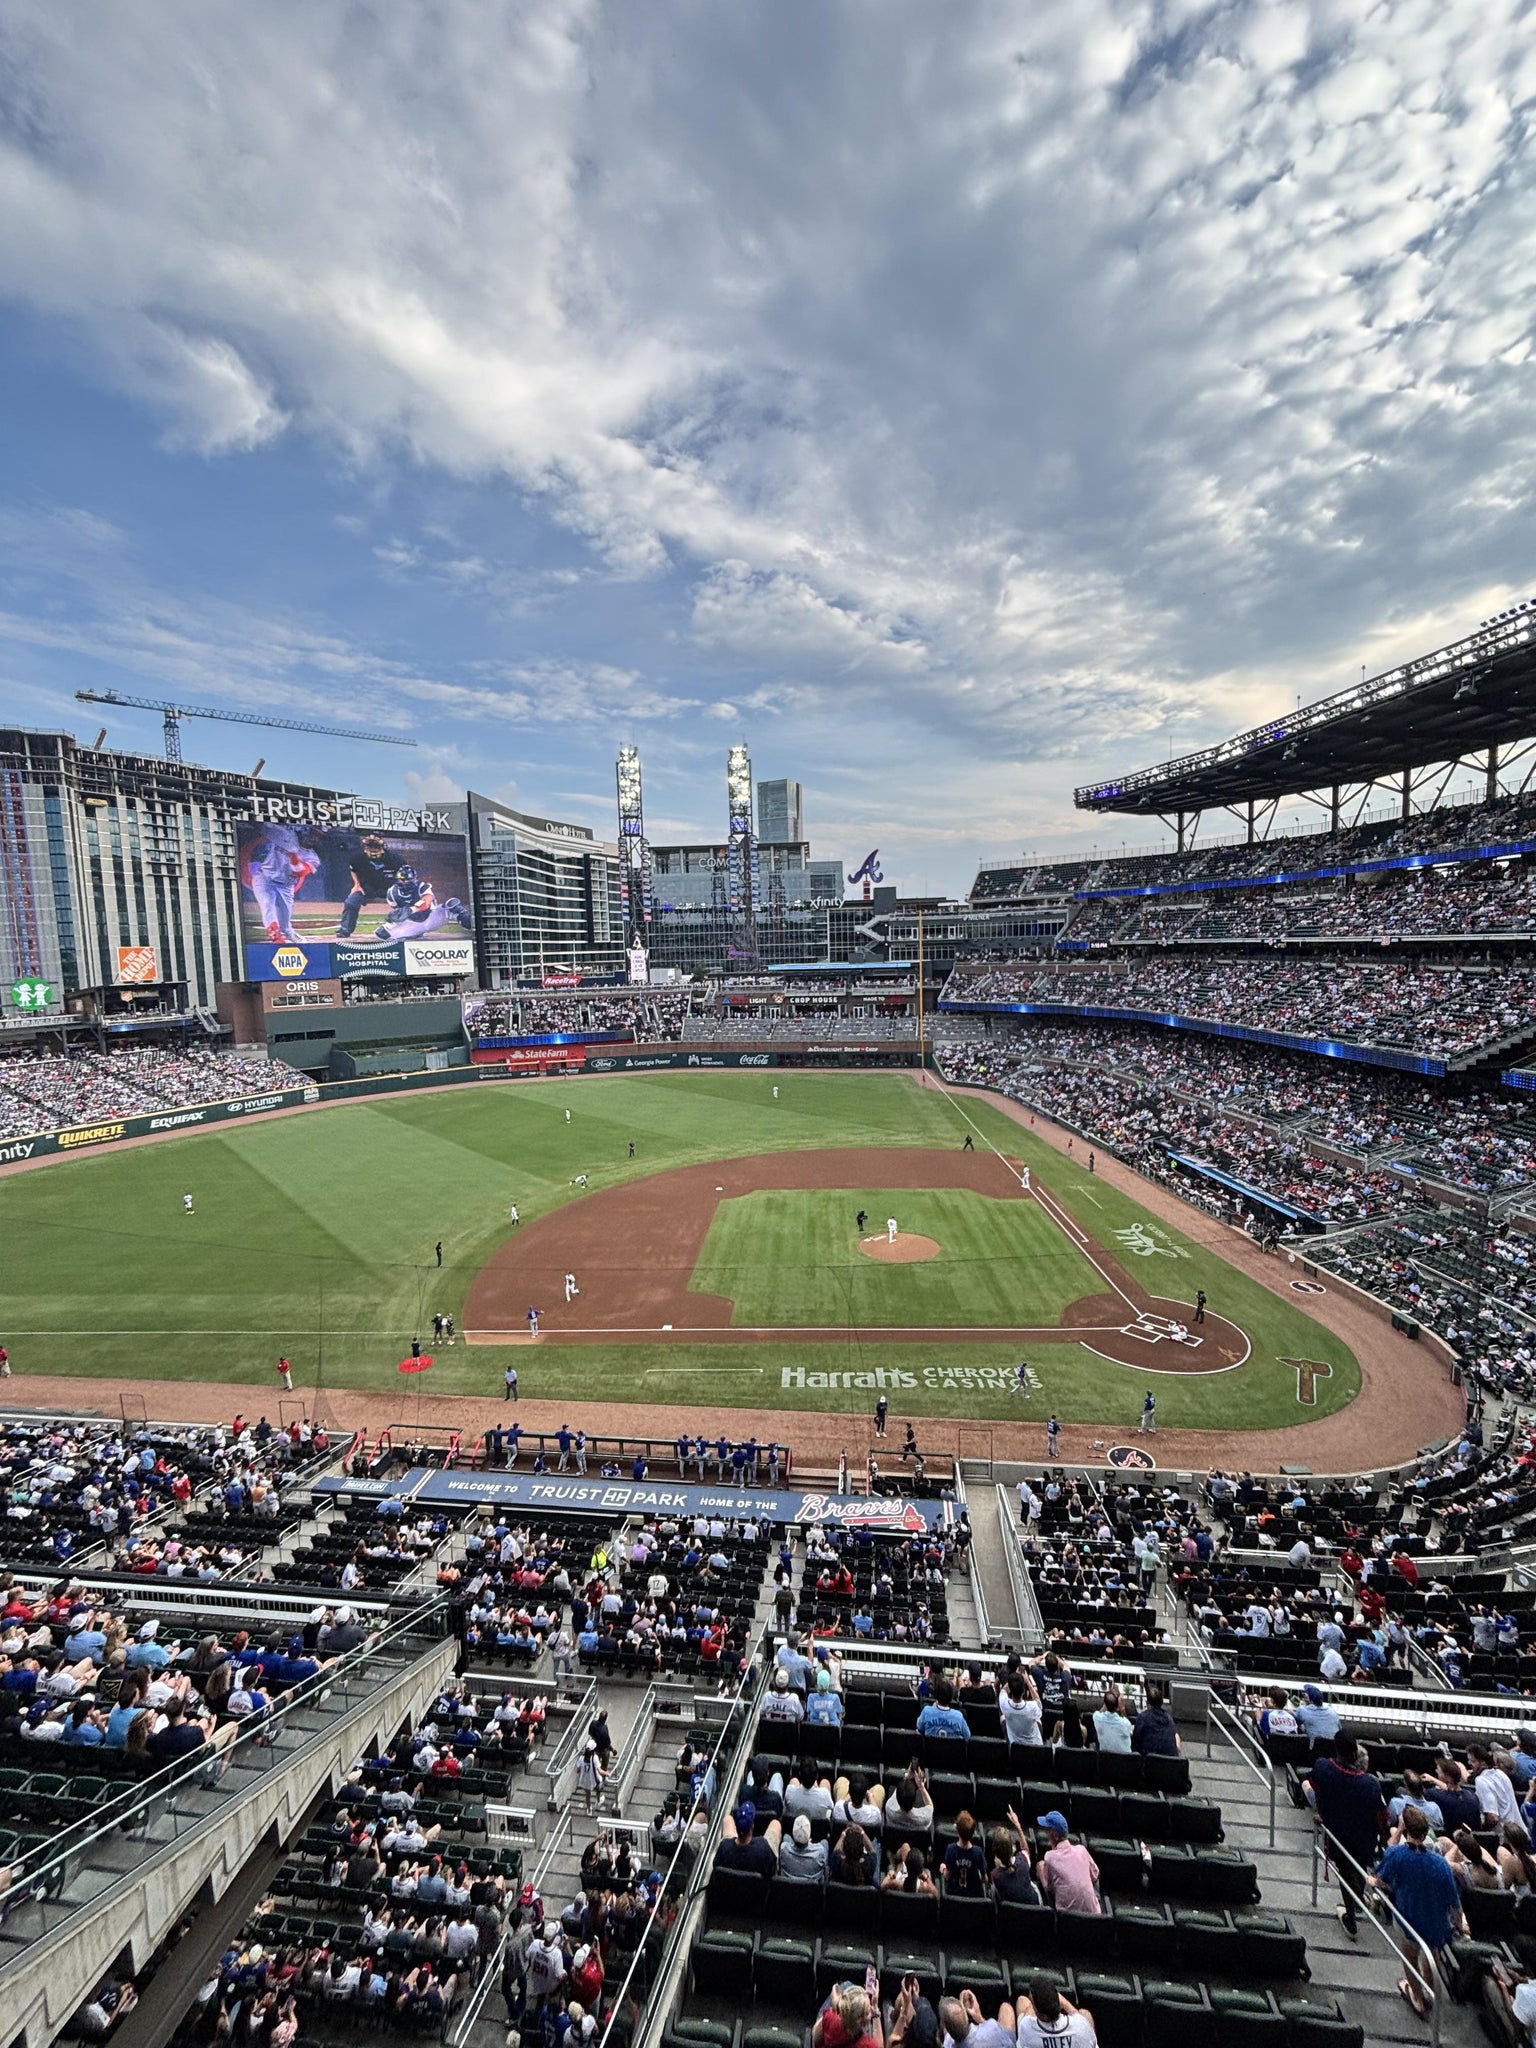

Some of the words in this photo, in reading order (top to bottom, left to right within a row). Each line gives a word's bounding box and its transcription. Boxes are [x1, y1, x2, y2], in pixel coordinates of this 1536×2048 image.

[247, 796, 347, 822] TRUIST
[389, 807, 451, 830] PARK
[809, 896, 846, 909] xfinity
[337, 951, 400, 961] NORTHSIDE
[415, 949, 469, 961] COOLRAY
[120, 946, 155, 980] HOME
[278, 956, 303, 968] NAPA
[286, 981, 319, 992] ORIS
[544, 977, 578, 986] RaceTrac
[595, 1059, 613, 1068] Ford
[634, 1059, 655, 1067] Georgia
[244, 1096, 283, 1109] HYUNDAI
[150, 1110, 207, 1129] EQUIFAX
[58, 1124, 125, 1145] QUIKRETE
[448, 1480, 500, 1492] WELCOME
[503, 1485, 518, 1494] TO
[531, 1484, 602, 1501] TRUIST
[631, 1492, 688, 1508] PARK
[700, 1498, 736, 1508] HOME
[736, 1500, 752, 1508] OF
[755, 1500, 778, 1511] THE
[794, 1493, 903, 1523] Braves
